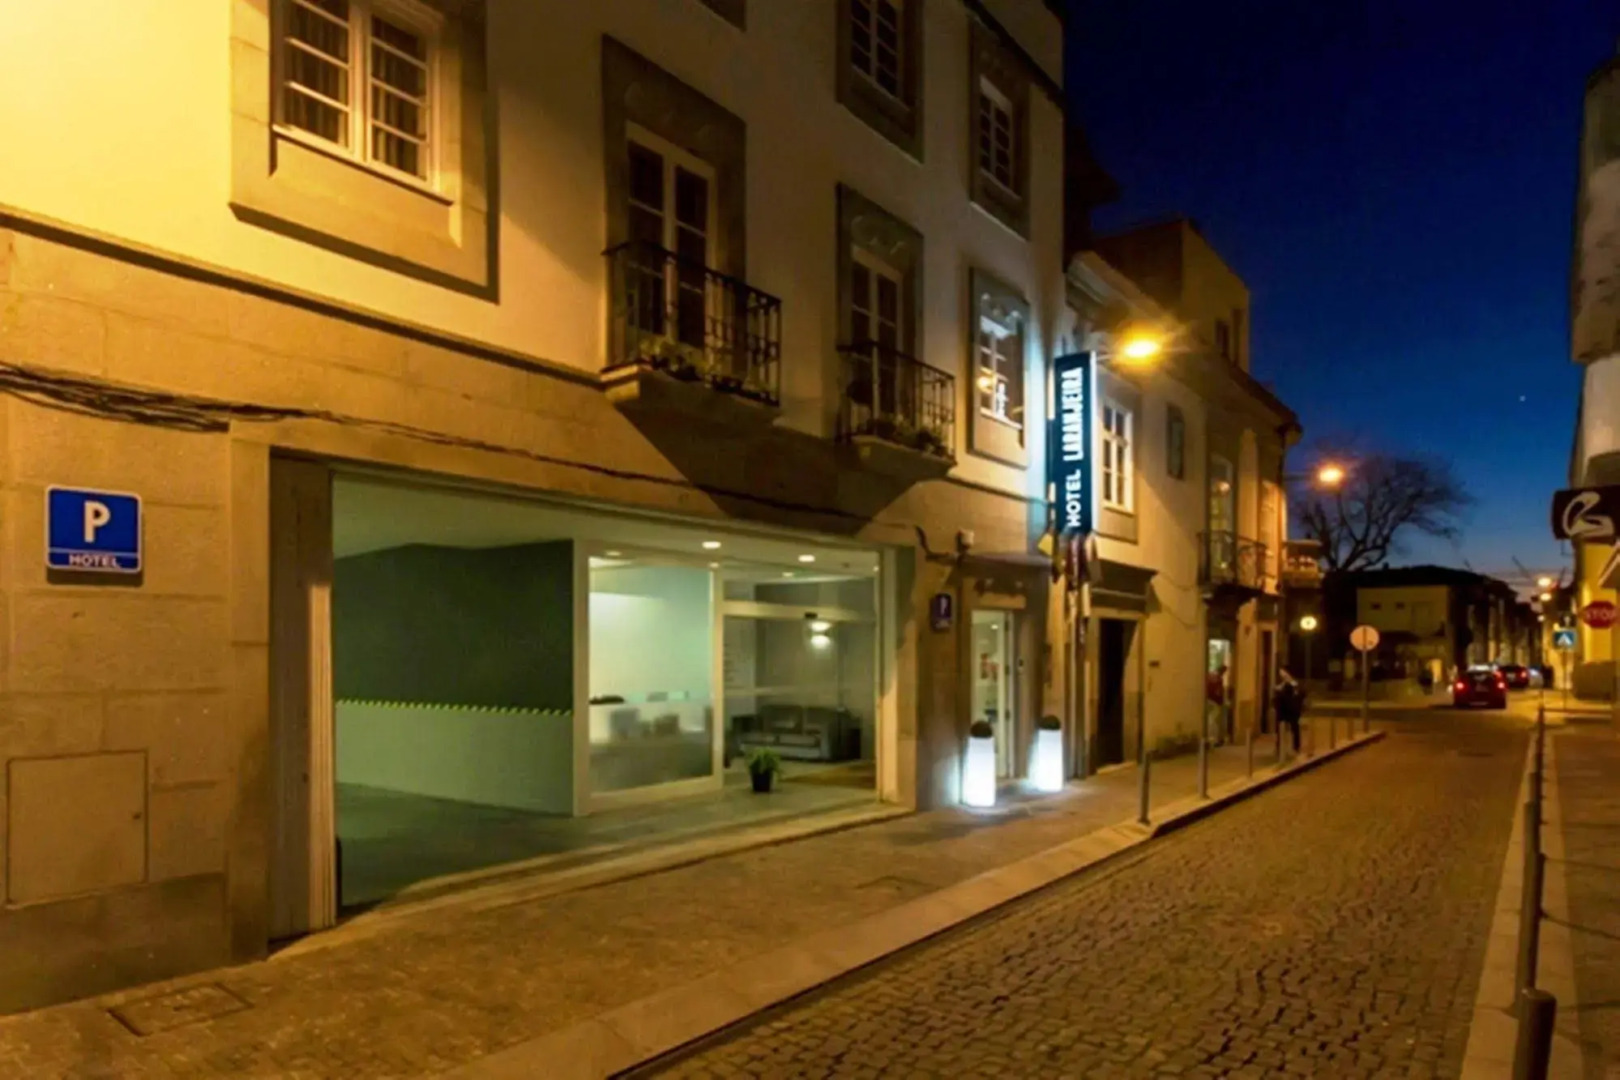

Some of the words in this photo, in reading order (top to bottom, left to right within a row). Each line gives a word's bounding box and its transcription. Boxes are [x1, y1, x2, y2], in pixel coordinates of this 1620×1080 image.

[1061, 366, 1084, 461] LARANJEIRA
[1065, 469, 1081, 527] HOTEL
[84, 501, 111, 543] P
[68, 554, 119, 568] HOTEL
[1586, 607, 1617, 622] STOP
